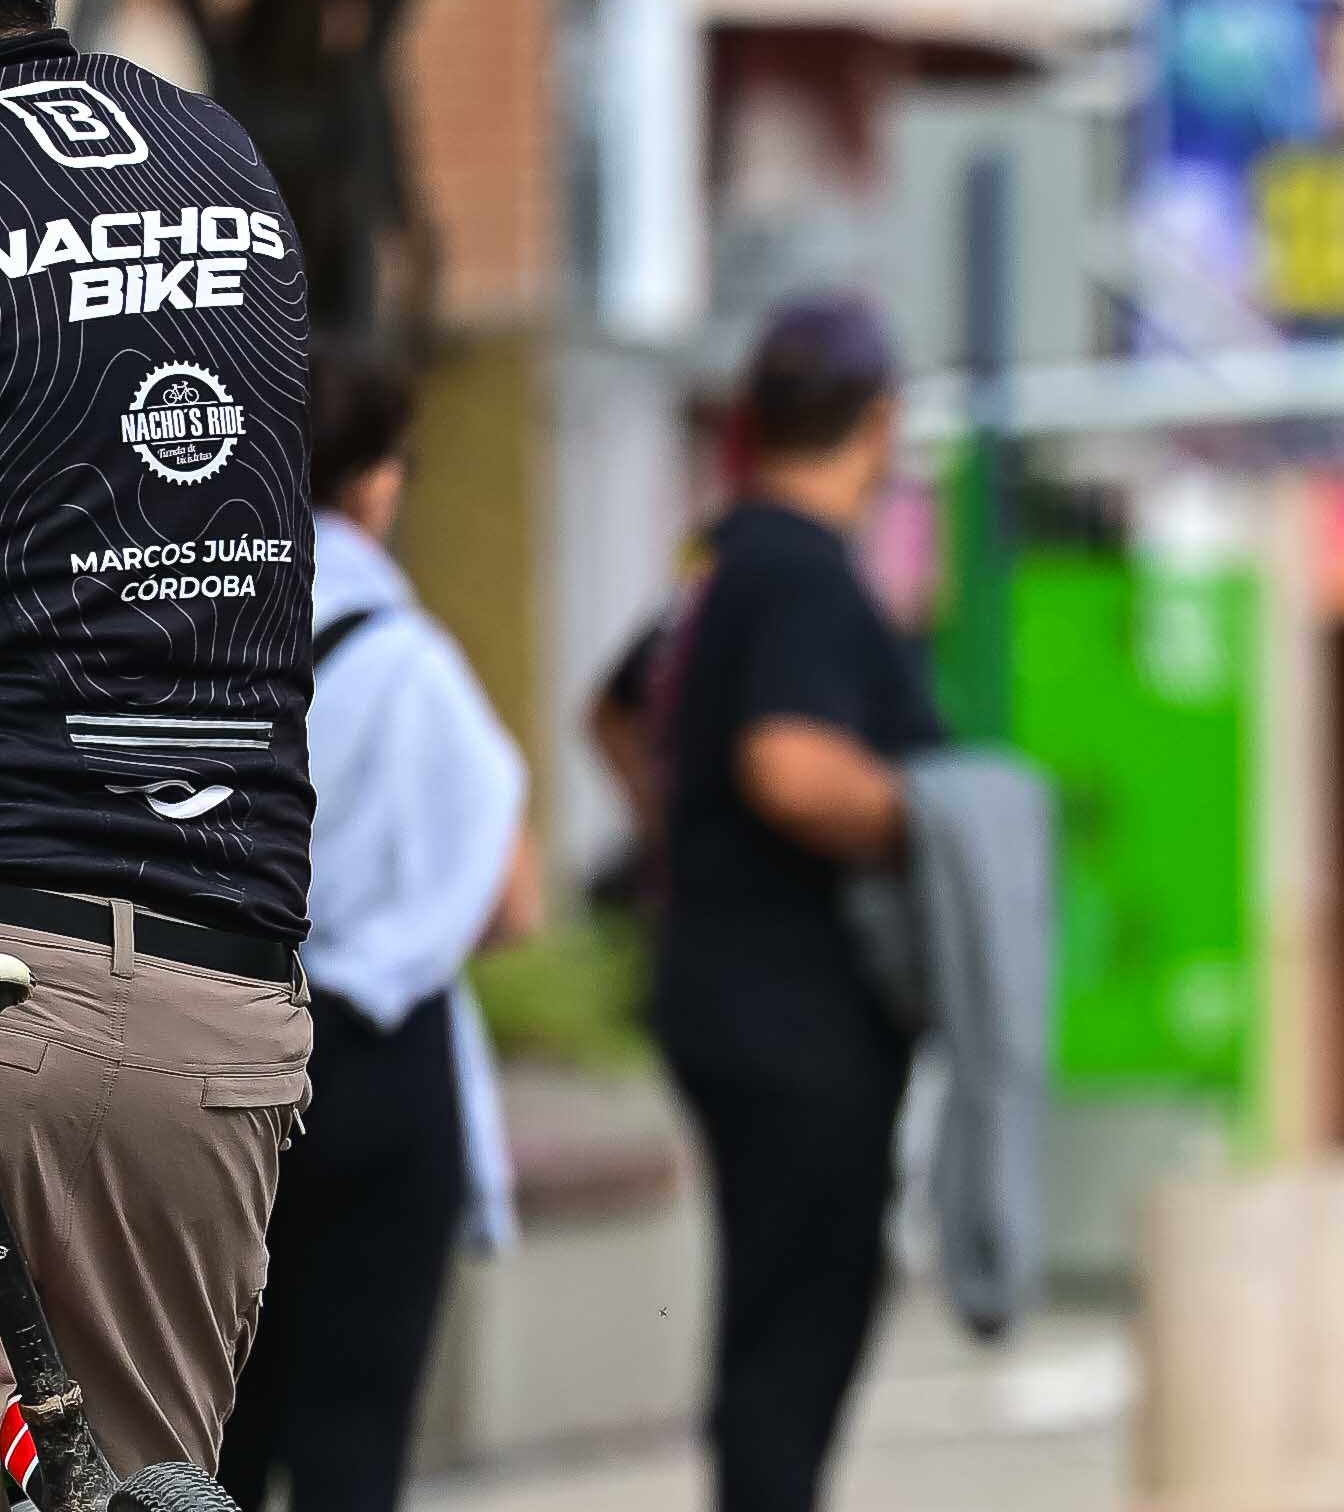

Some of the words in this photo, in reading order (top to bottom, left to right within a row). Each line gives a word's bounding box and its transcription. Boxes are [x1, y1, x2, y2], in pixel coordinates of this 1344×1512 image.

[69, 258, 248, 322] BIKE
[206, 405, 247, 436] RIDE
[70, 541, 197, 574] MARCOS
[202, 533, 292, 563] JUÁREZ
[120, 574, 257, 603] CÓRDOBA
